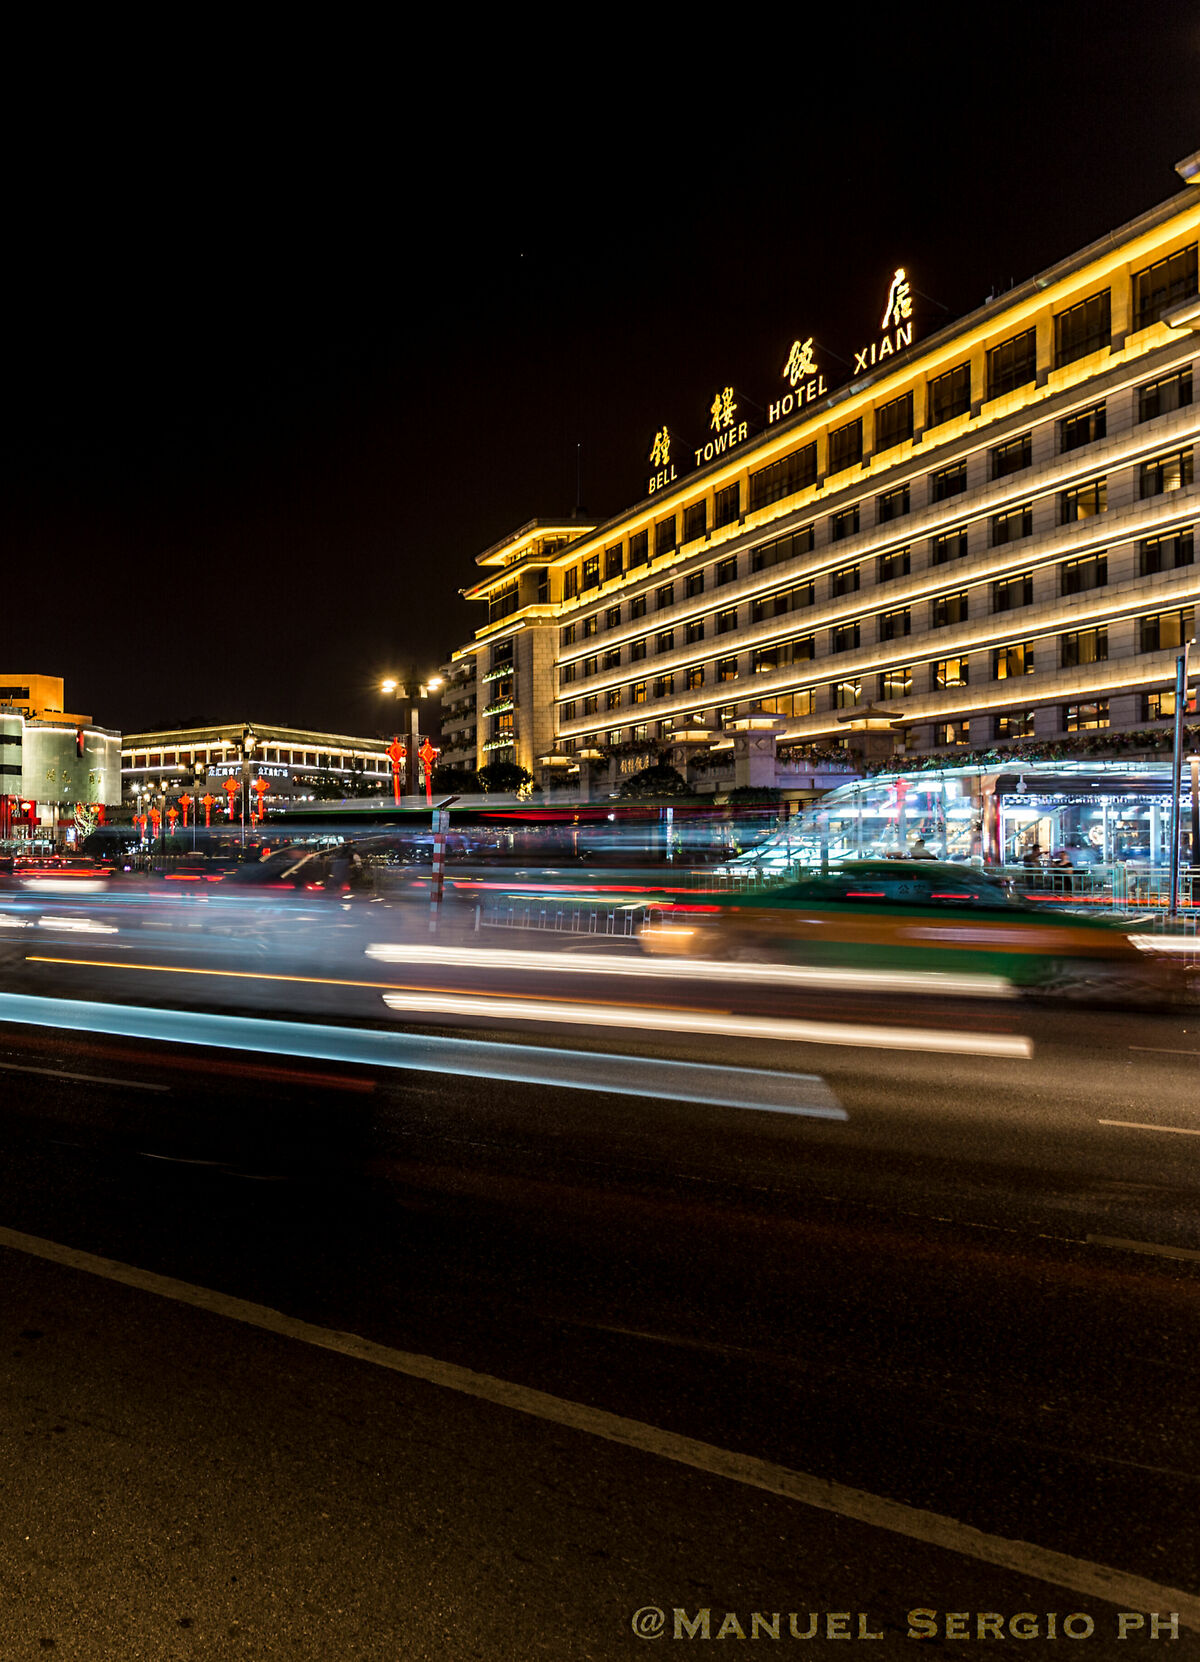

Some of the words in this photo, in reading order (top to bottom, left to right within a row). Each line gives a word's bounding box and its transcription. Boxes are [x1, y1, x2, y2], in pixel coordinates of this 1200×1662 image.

[648, 465, 677, 494] BELL
[694, 421, 748, 466] TOWER
[769, 375, 828, 423] HOTEL
[854, 322, 912, 375] XIAN
